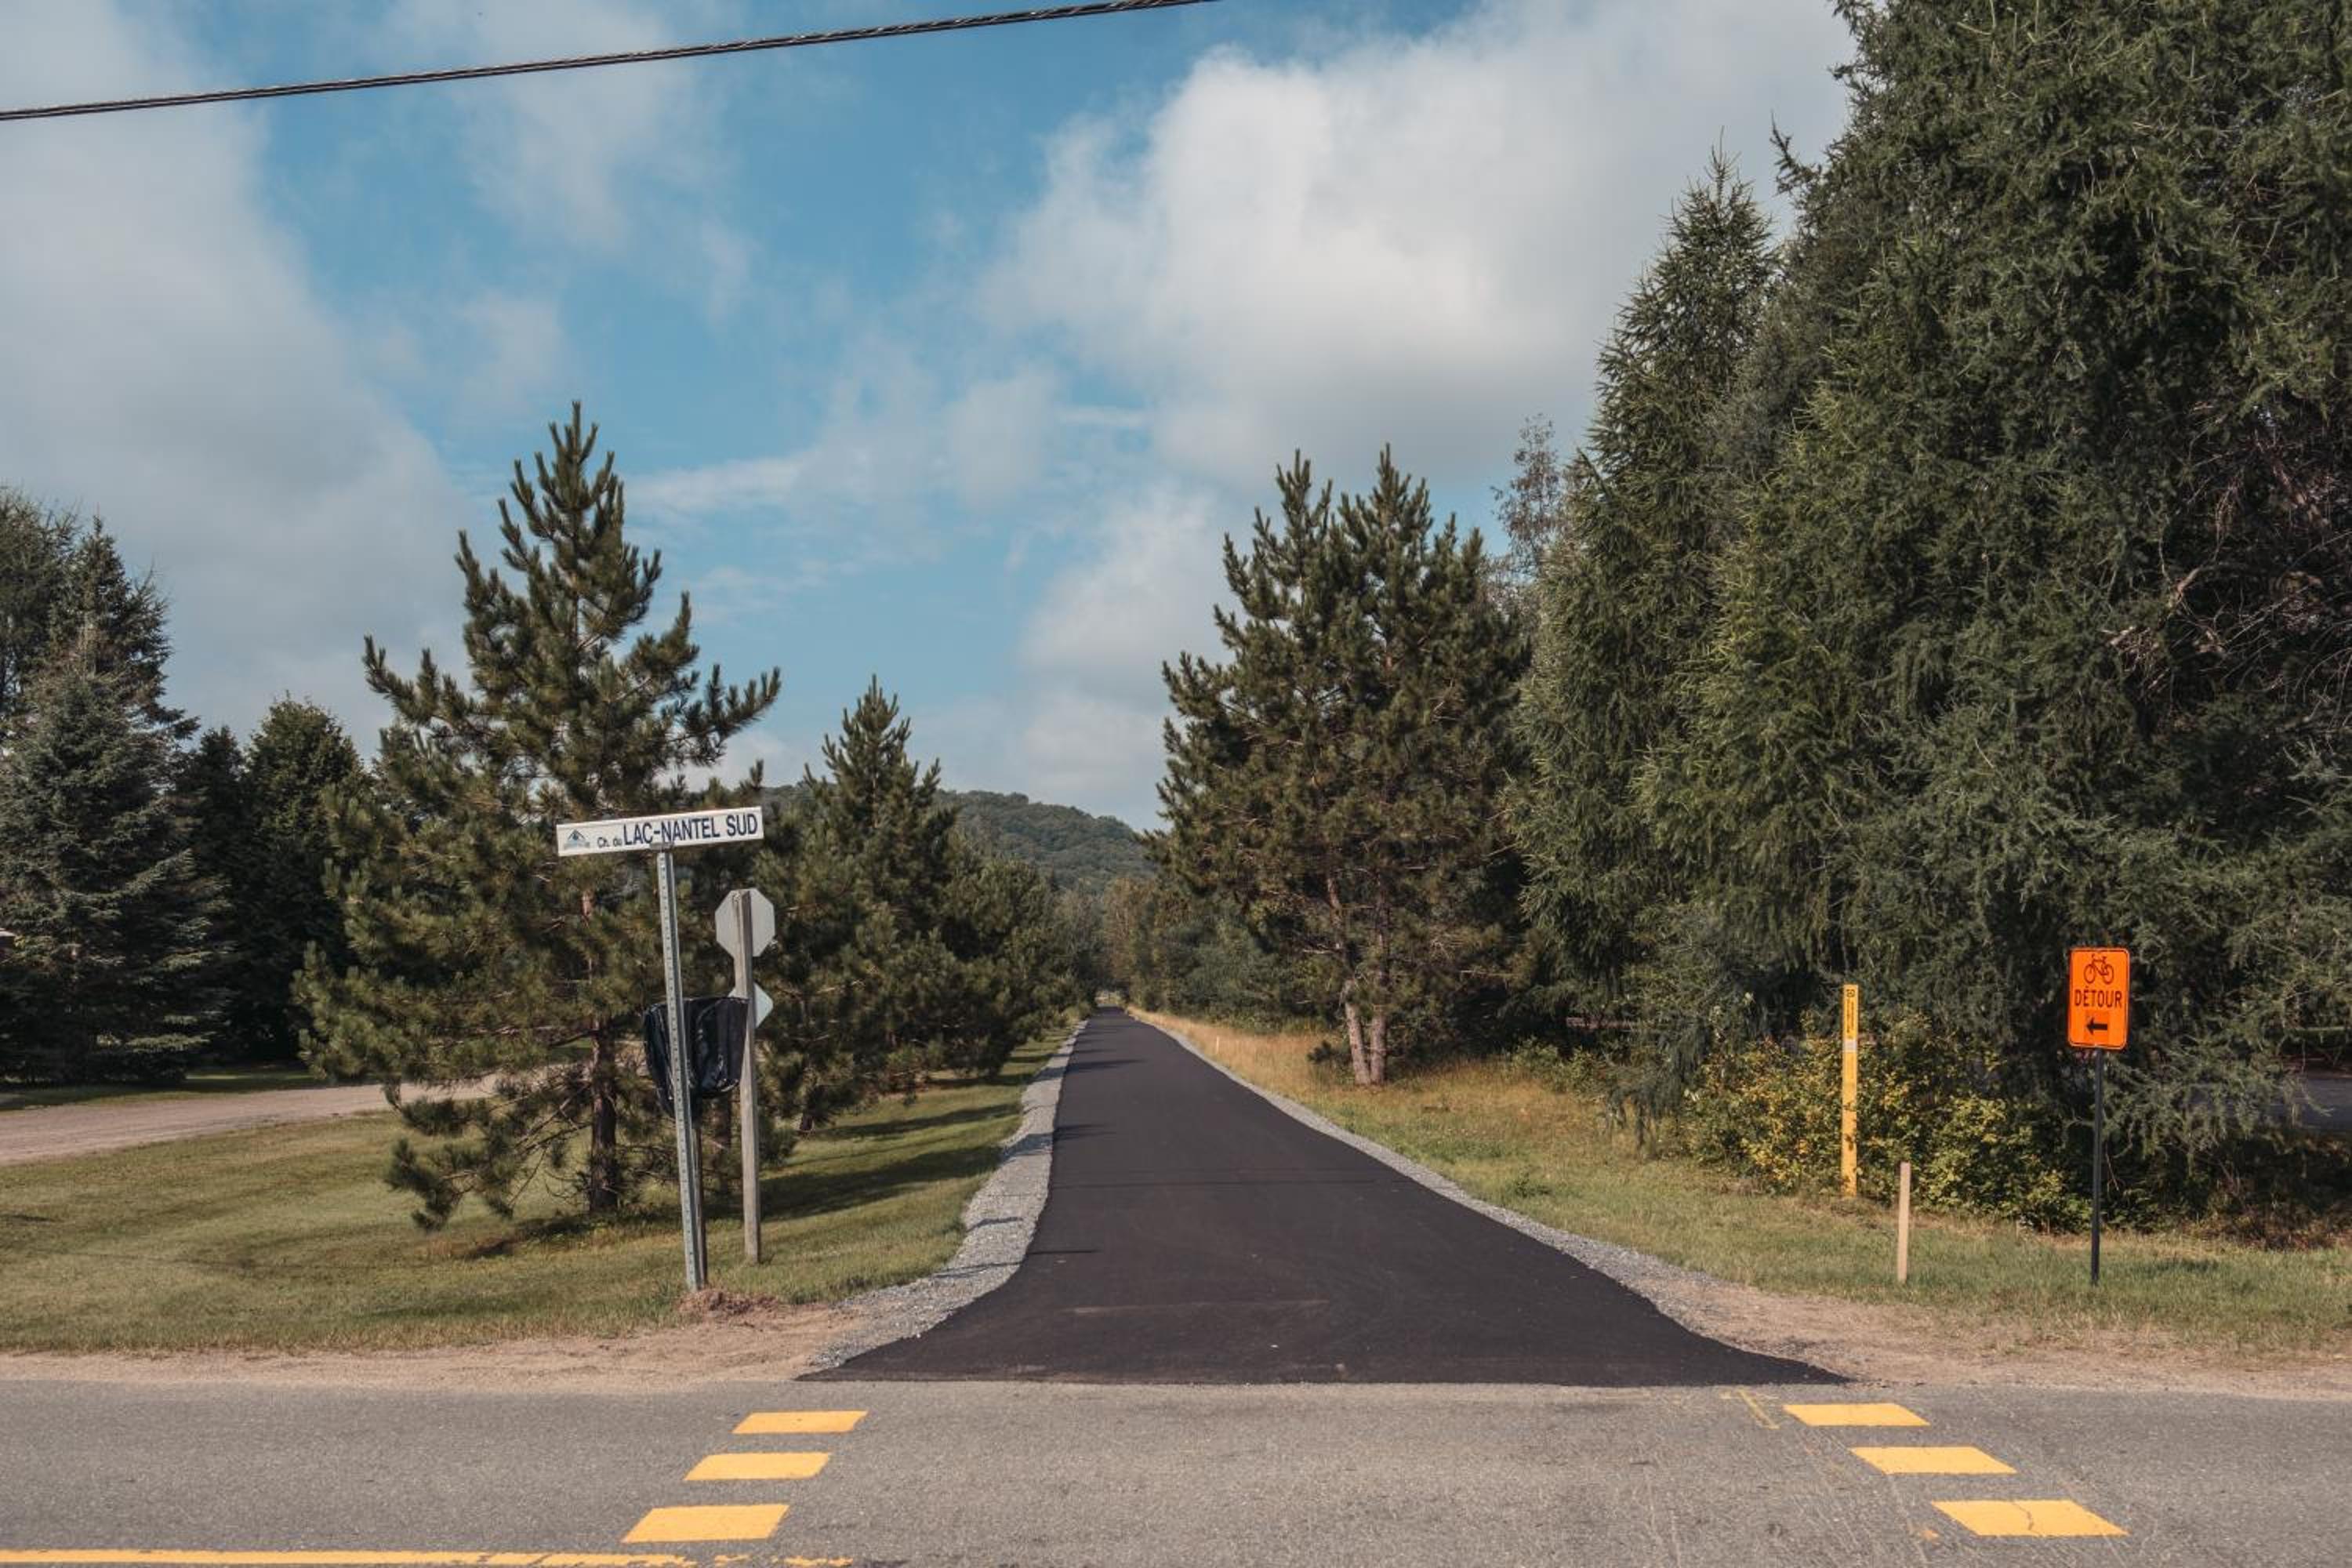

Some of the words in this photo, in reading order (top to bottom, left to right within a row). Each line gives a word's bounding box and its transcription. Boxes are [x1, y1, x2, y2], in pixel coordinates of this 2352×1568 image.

[623, 818, 720, 845] LAC-NANTEL
[726, 813, 758, 837] SUD
[2074, 985, 2122, 1007] DÉTOUR
